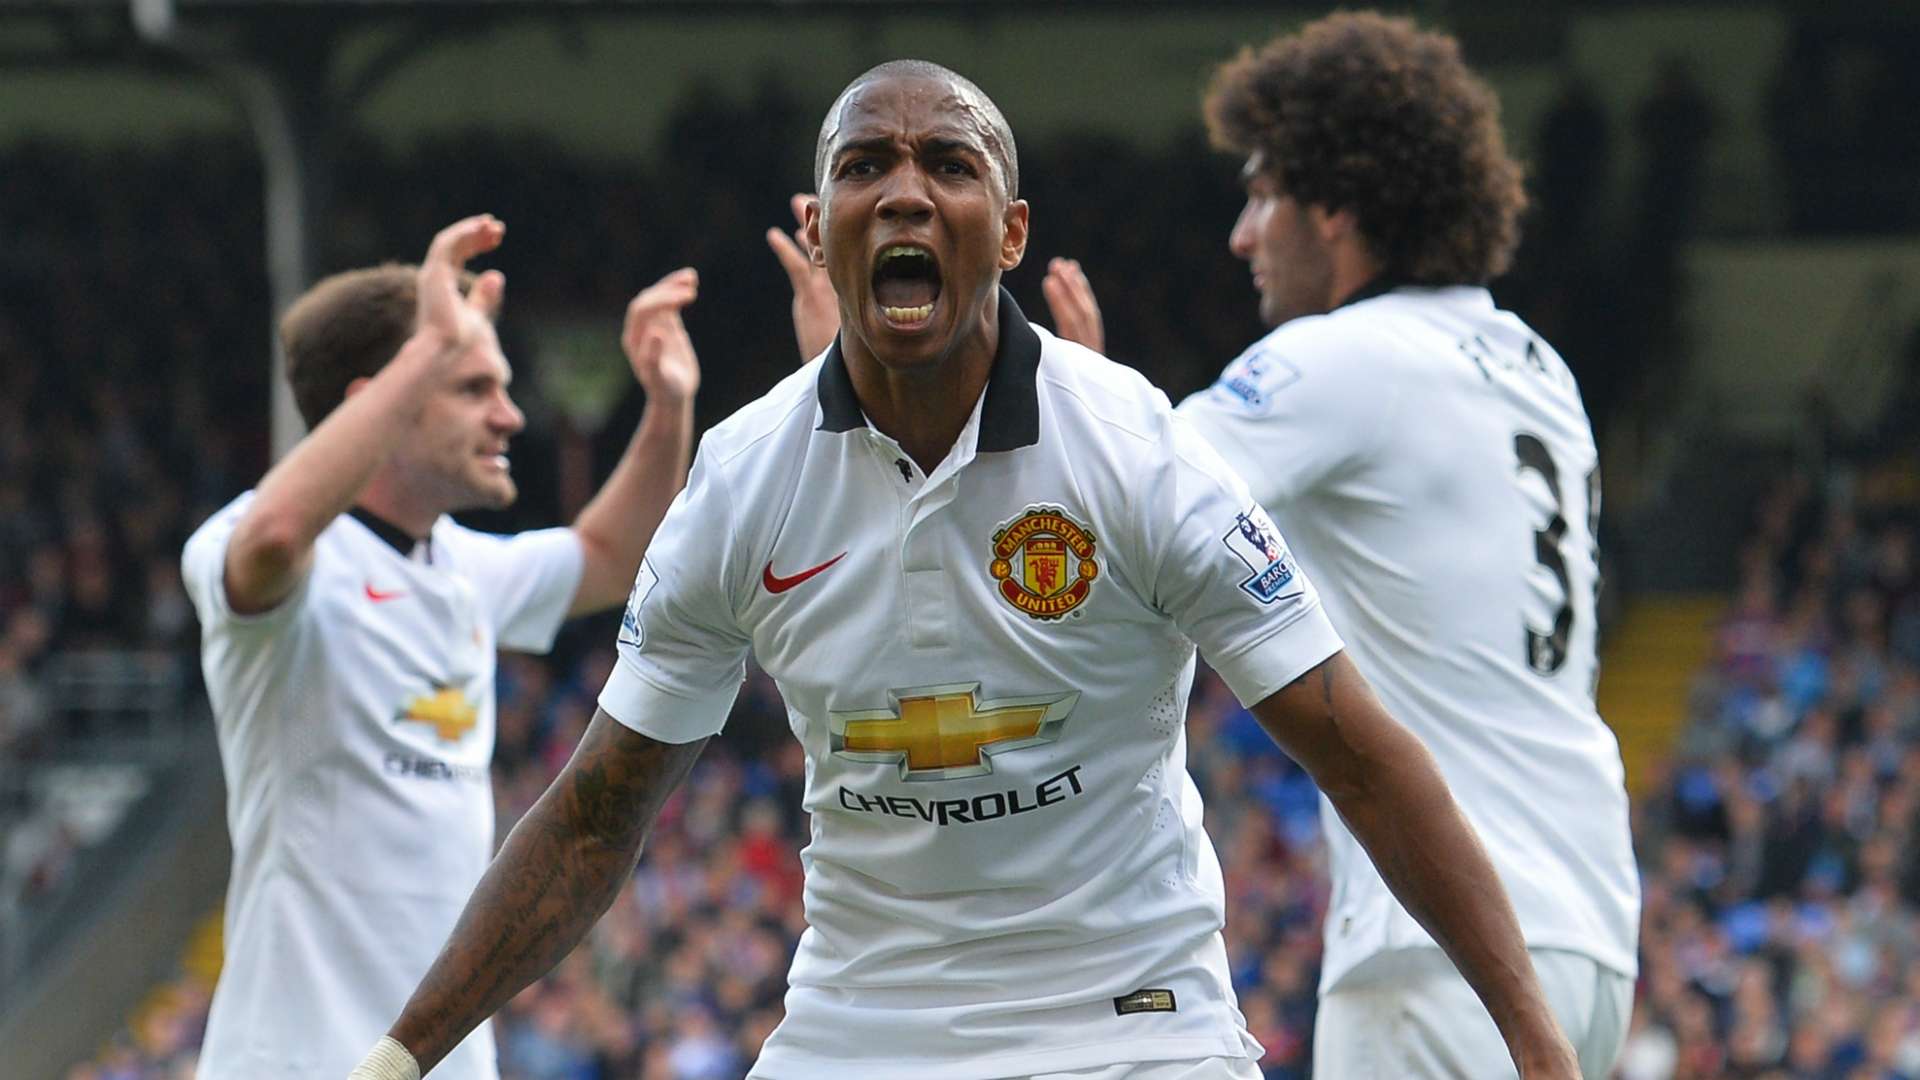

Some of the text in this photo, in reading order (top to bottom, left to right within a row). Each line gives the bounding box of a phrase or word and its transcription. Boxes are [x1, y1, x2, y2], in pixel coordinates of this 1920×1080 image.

[1002, 518, 1088, 553] MANCHESTER
[1016, 593, 1077, 612] UNITED
[839, 764, 1083, 826] CHEVROLET
